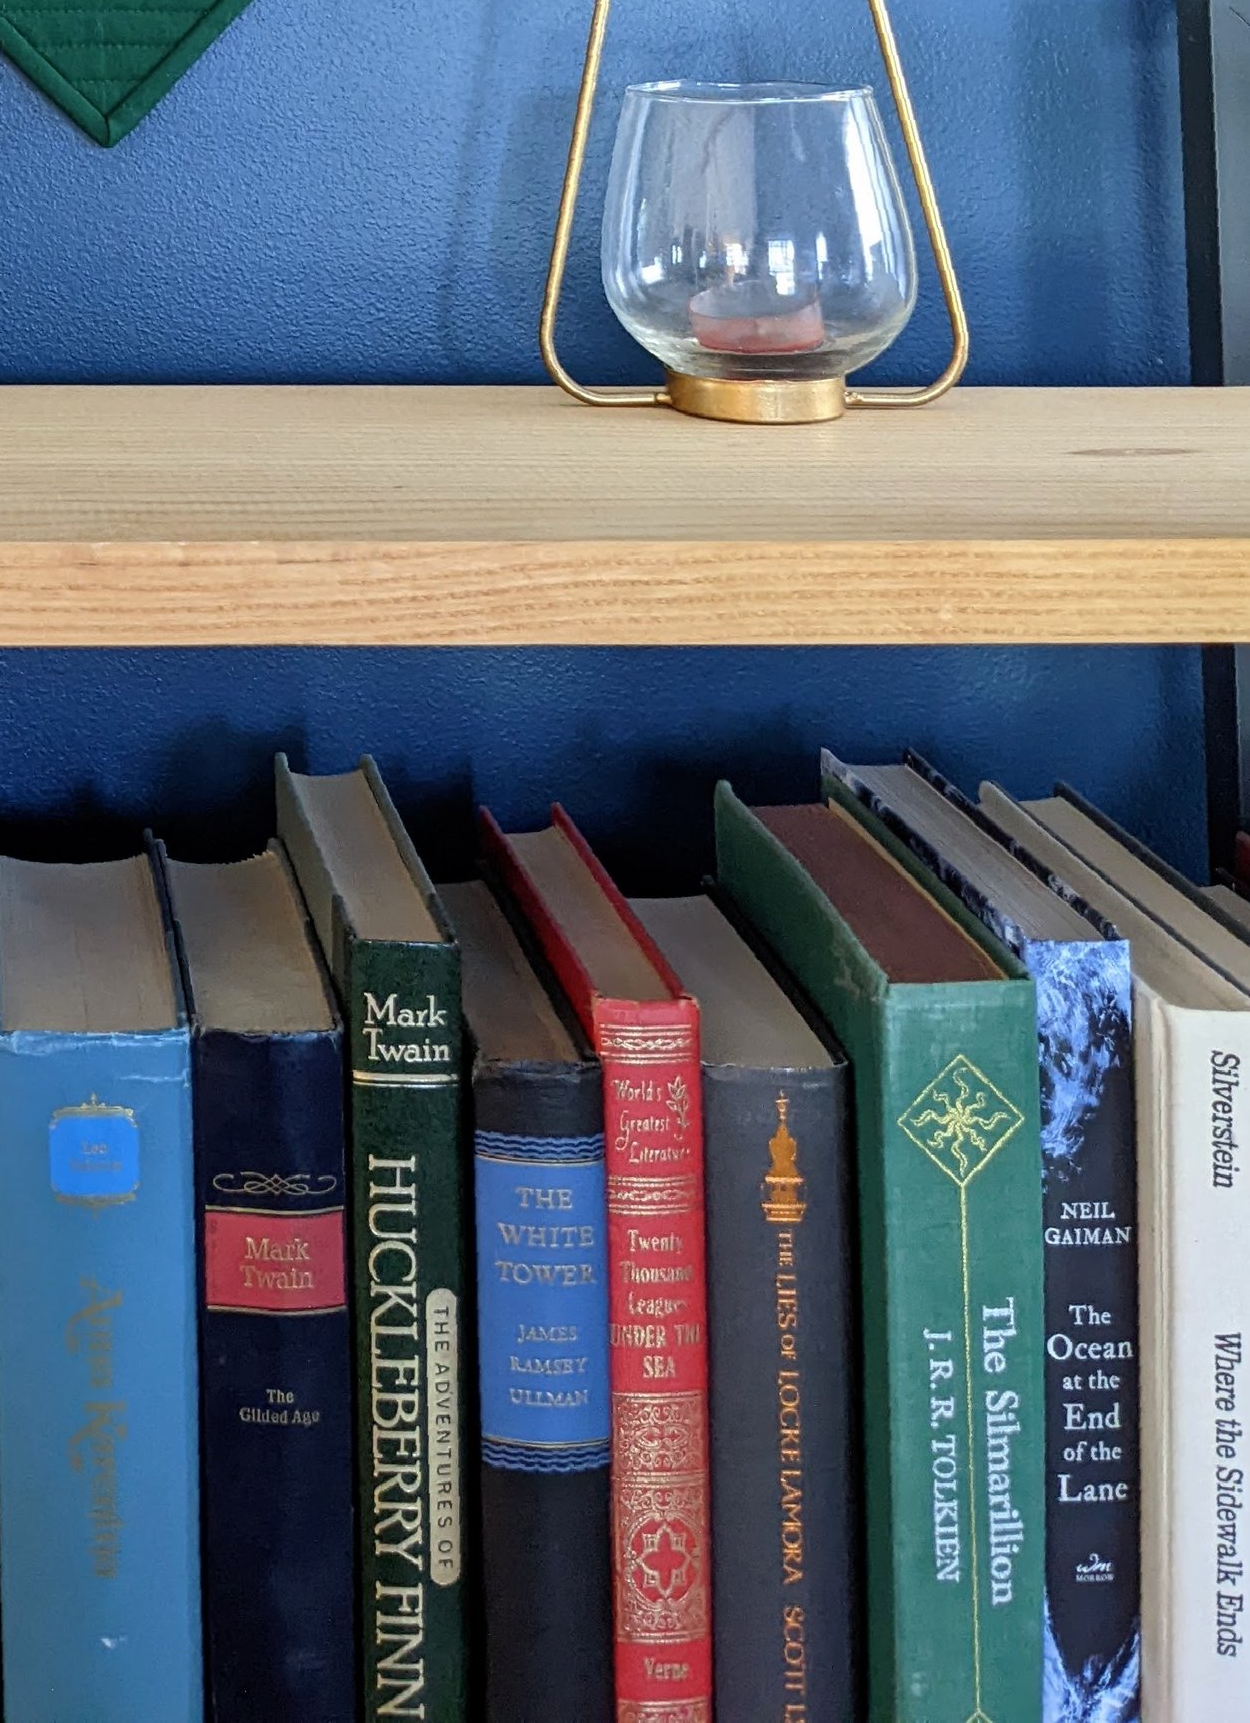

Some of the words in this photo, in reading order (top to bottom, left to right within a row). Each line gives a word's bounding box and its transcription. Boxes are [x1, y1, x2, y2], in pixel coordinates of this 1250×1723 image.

[364, 992, 447, 1028] Mark
[363, 1028, 450, 1063] Twain
[615, 1110, 670, 1151] Greatest
[1211, 1049, 1240, 1189] Silverstein
[515, 1187, 573, 1211] THE
[1060, 1201, 1116, 1220] NEIL
[245, 1237, 310, 1261] Mark
[497, 1222, 595, 1248] WHITE
[627, 1229, 682, 1254] Twenty
[778, 1231, 794, 1267] THE
[1044, 1226, 1132, 1246] GAIMAN
[240, 1265, 314, 1290] Twain
[495, 1261, 596, 1286] TOWER
[776, 1273, 797, 1328] LIES
[1069, 1304, 1111, 1325] The
[434, 1305, 451, 1352] THE
[517, 1324, 577, 1344] JAMES
[609, 1324, 666, 1348] UNDER
[922, 1328, 952, 1351] J.
[981, 1296, 1017, 1374] The
[1046, 1333, 1135, 1360] Ocean
[368, 1154, 424, 1572] HUCKLEBERRY
[510, 1356, 588, 1375] RAMSEY
[643, 1355, 675, 1378] SEA
[928, 1358, 953, 1390] R.
[1214, 1332, 1242, 1413] Where
[1062, 1374, 1082, 1390] at
[1088, 1369, 1120, 1390] the
[266, 1388, 294, 1404] The
[510, 1388, 588, 1407] ULLMAN
[239, 1406, 288, 1425] Gilded
[291, 1408, 320, 1428] Age
[778, 1370, 799, 1463] LOCKE
[929, 1396, 955, 1429] R.
[1064, 1402, 1121, 1431] End
[434, 1362, 453, 1529] ADVENTURES
[1063, 1439, 1087, 1462] of
[1090, 1439, 1123, 1461] the
[1215, 1419, 1243, 1460] the
[984, 1388, 1024, 1607] Silmarillion
[1057, 1474, 1130, 1503] Lane
[931, 1433, 960, 1583] TOLKIEN
[780, 1470, 803, 1585] LAMORA
[1215, 1463, 1244, 1584] Sidewalk
[436, 1538, 454, 1569] OF
[1216, 1590, 1245, 1658] Ends
[375, 1580, 426, 1722] FINN
[783, 1605, 806, 1696] SCOTT
[643, 1657, 688, 1681] Verne
